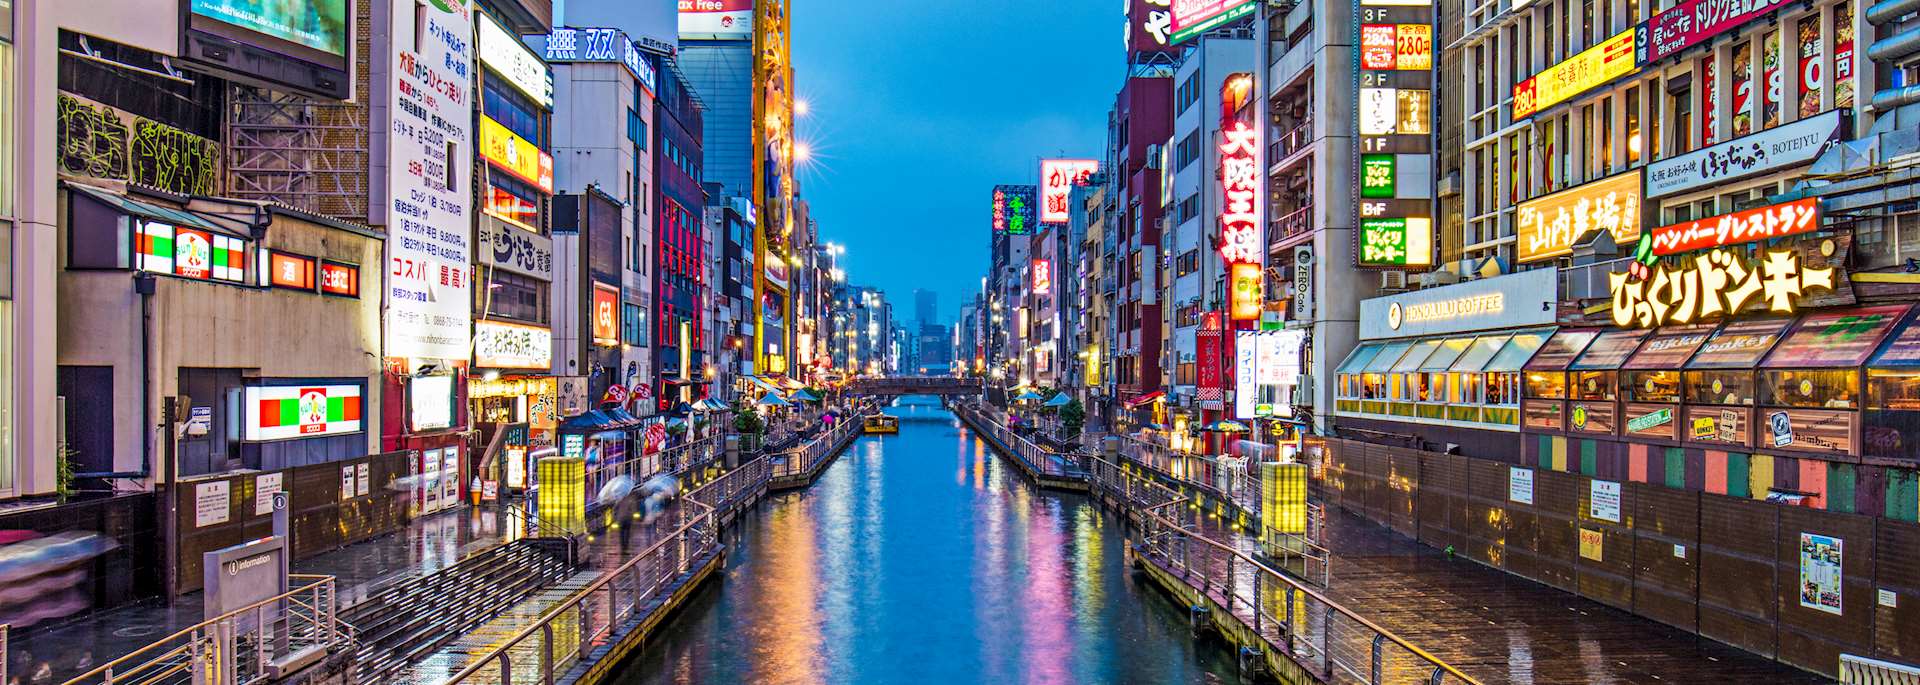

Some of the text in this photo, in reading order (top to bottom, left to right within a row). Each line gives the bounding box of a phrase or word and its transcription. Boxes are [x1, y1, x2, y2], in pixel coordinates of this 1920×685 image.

[1365, 9, 1387, 21] 3F
[1398, 36, 1430, 55] 280円
[1365, 74, 1387, 86] 2F
[1365, 138, 1387, 151] 1F
[1772, 133, 1819, 155] BOTEJYU
[1220, 122, 1256, 263] 大阪王将
[1521, 206, 1536, 228] 2F
[1652, 203, 1816, 249] ハンバーグレストラン
[282, 261, 297, 281] 酒
[321, 269, 349, 289] たばこ
[394, 257, 427, 282] コスパ
[1298, 265, 1307, 293] ZERO
[1609, 249, 1834, 328] びっくりドンキー
[1405, 292, 1503, 322] HONOLULU COFFEE
[239, 554, 271, 570] information
